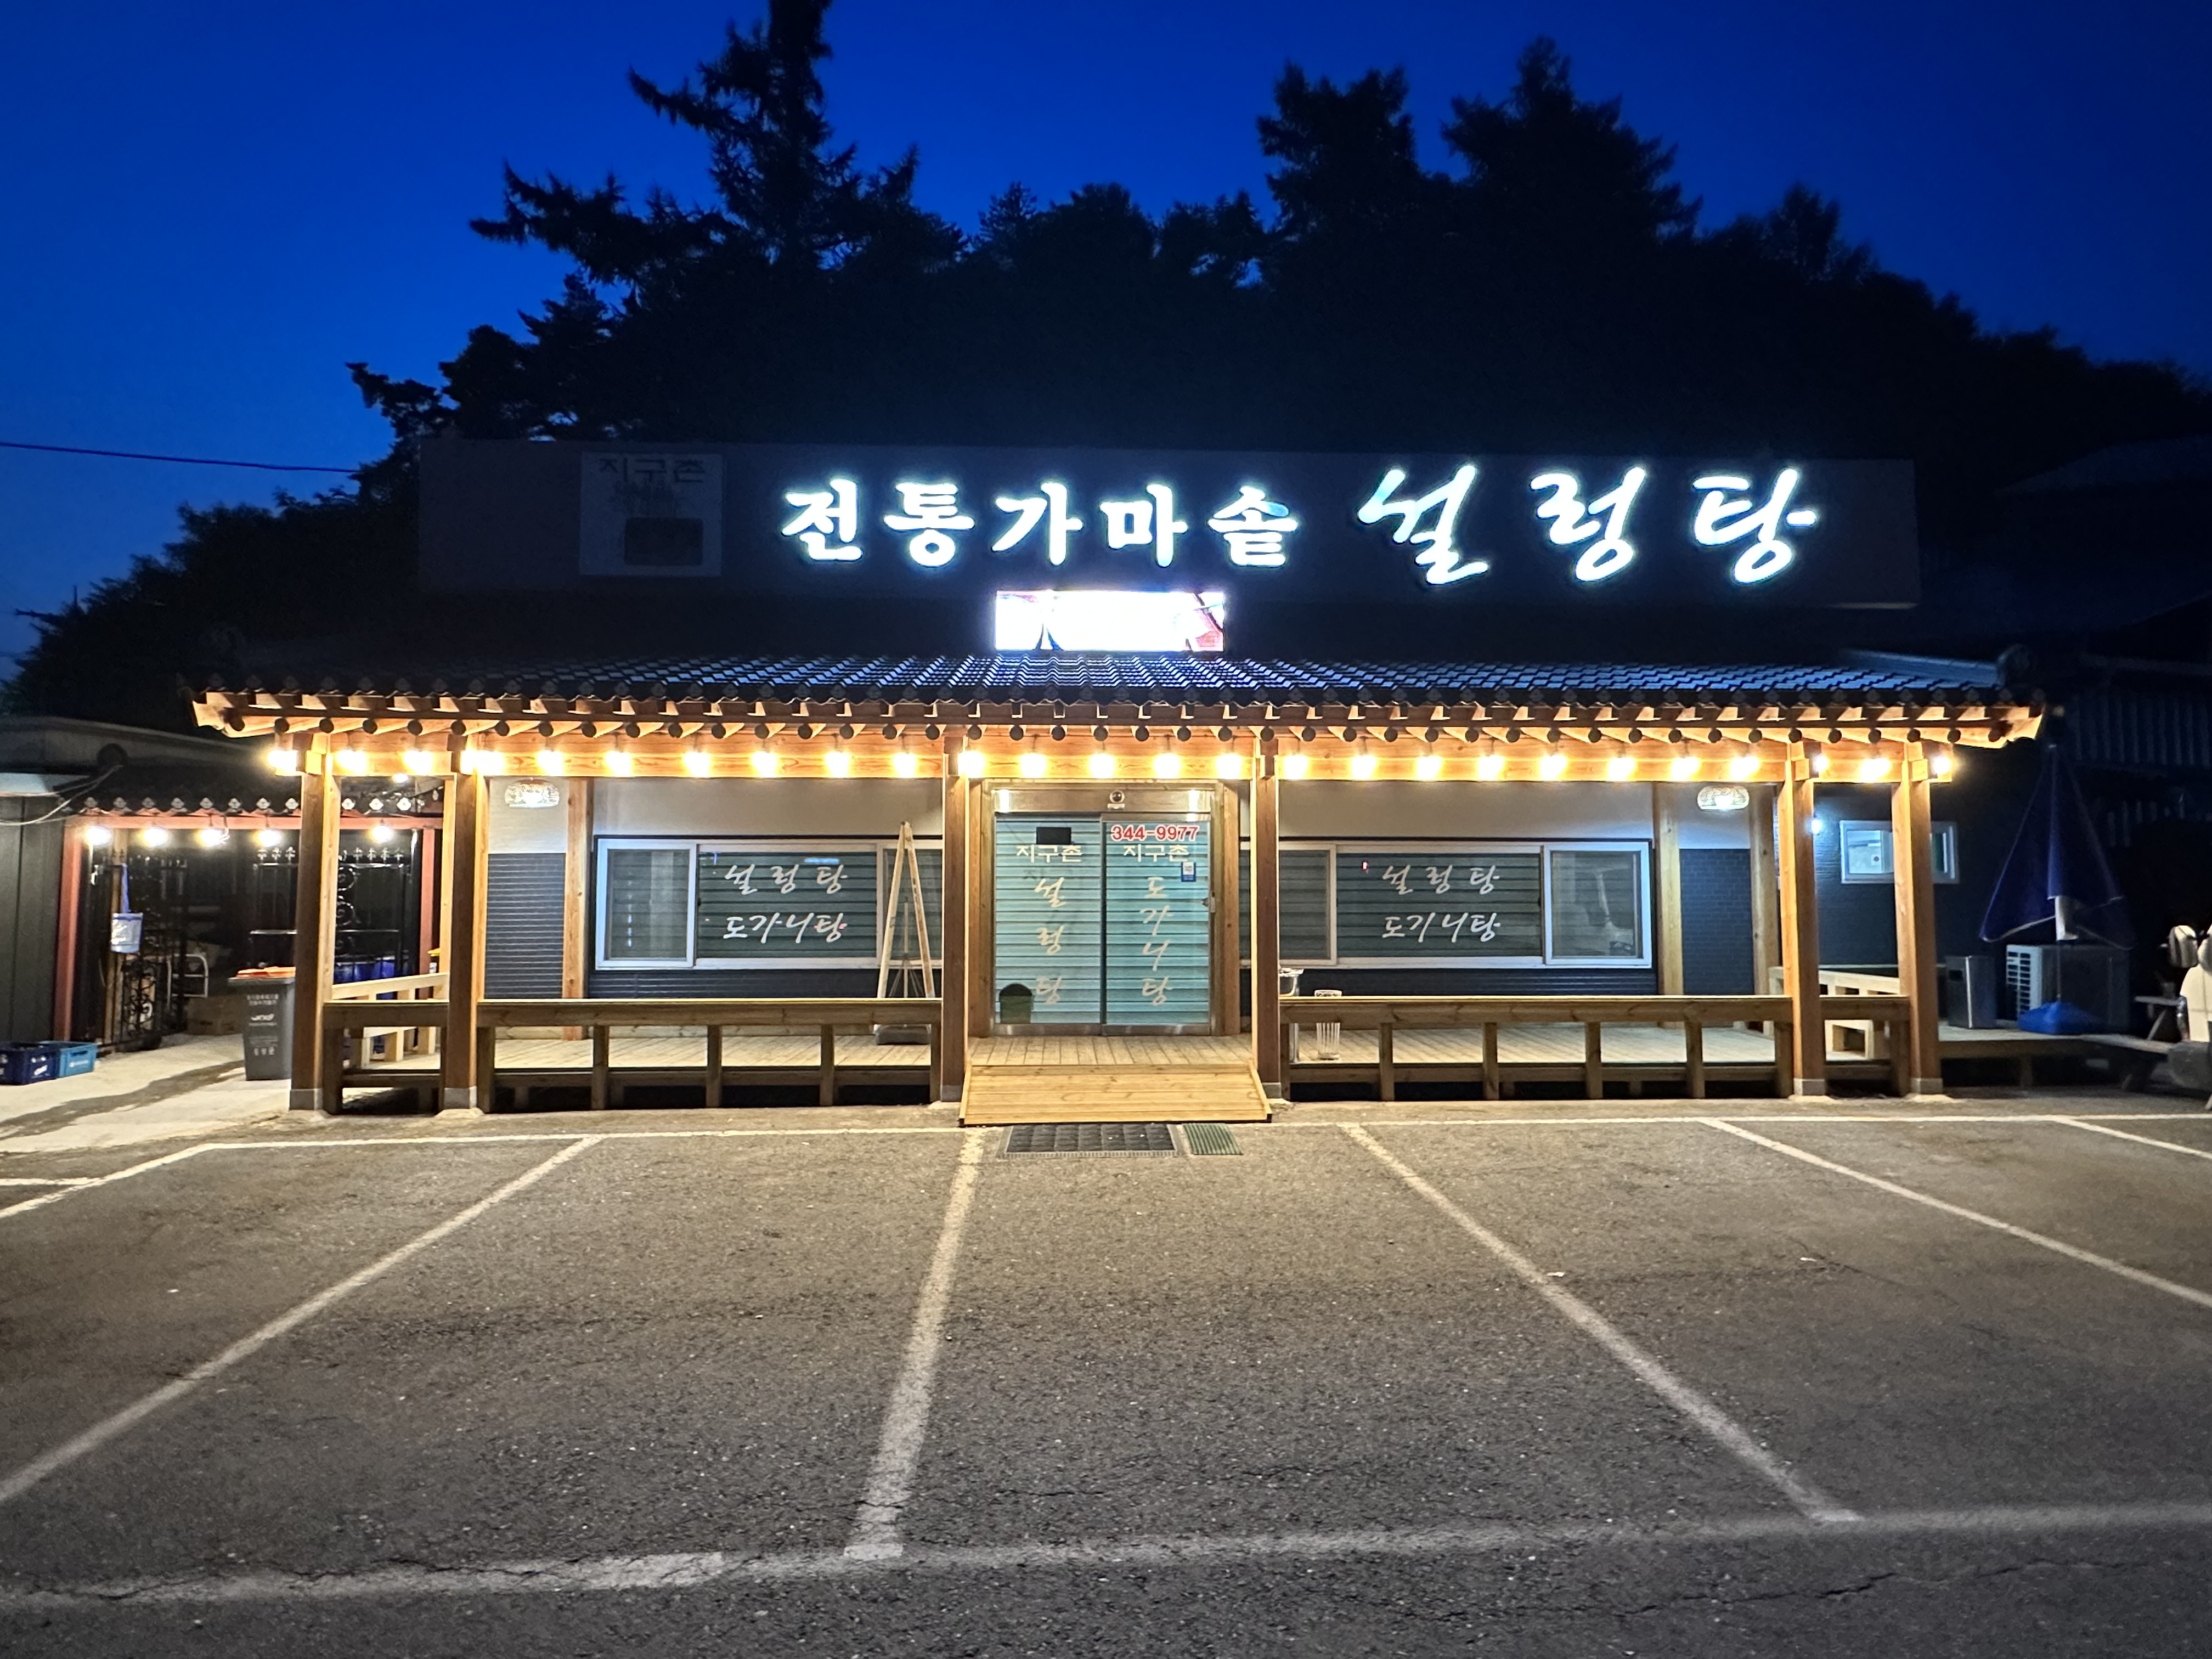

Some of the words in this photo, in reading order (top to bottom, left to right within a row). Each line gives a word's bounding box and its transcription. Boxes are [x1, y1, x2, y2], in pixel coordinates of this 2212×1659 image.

[598, 456, 706, 483] 지구촌
[781, 477, 1300, 568] 전통가마솥
[1357, 463, 1818, 585] 설렁탕
[1111, 825, 1199, 841] 344-9977
[1016, 844, 1082, 863] 지구촌
[1124, 844, 1190, 862] 지구촌
[725, 864, 848, 895] 설렁탕
[1382, 865, 1500, 895] 설렁탕
[723, 912, 848, 944] 도가니탕
[1139, 877, 1174, 1006] 도가니탕
